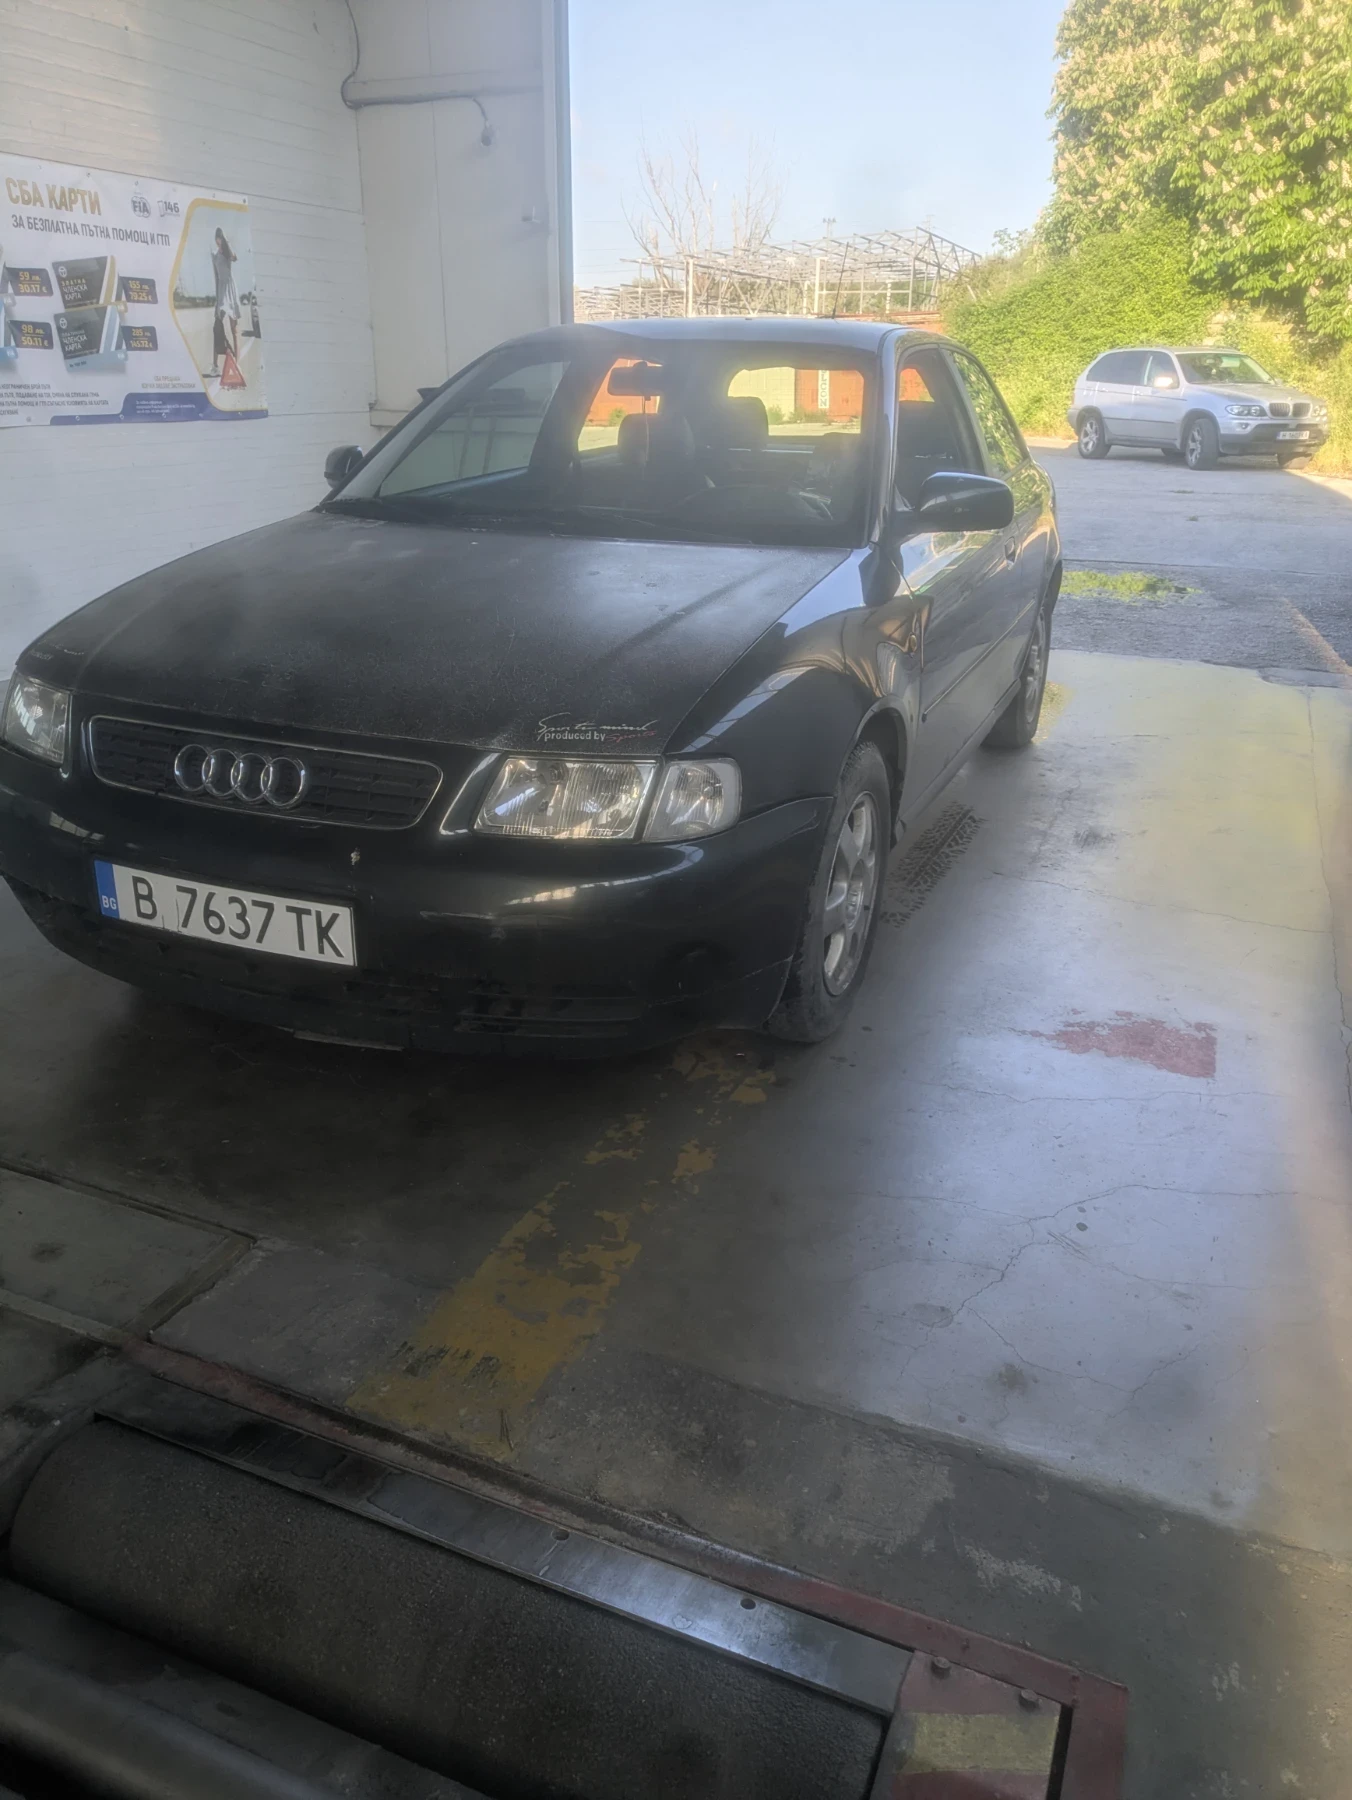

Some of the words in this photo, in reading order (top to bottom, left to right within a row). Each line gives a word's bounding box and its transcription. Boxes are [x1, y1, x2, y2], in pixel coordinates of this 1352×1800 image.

[5, 177, 45, 208] СБА
[46, 183, 102, 216] КАРТИ
[132, 200, 150, 214] FIA
[163, 201, 180, 213] 146
[11, 214, 25, 230] ЗА
[27, 216, 80, 236] БЕЗПЛАТНА
[81, 223, 111, 239] ПЪТНА
[112, 228, 150, 245] ПОМОЩ
[150, 233, 156, 245] И
[156, 234, 170, 246] ГТП
[19, 271, 30, 281] 59
[22, 324, 33, 333] 98
[544, 730, 592, 742] produced
[593, 730, 607, 742] by
[102, 895, 117, 910] BG
[131, 875, 158, 920] B
[176, 884, 275, 944] 7637
[285, 904, 345, 958] TK
